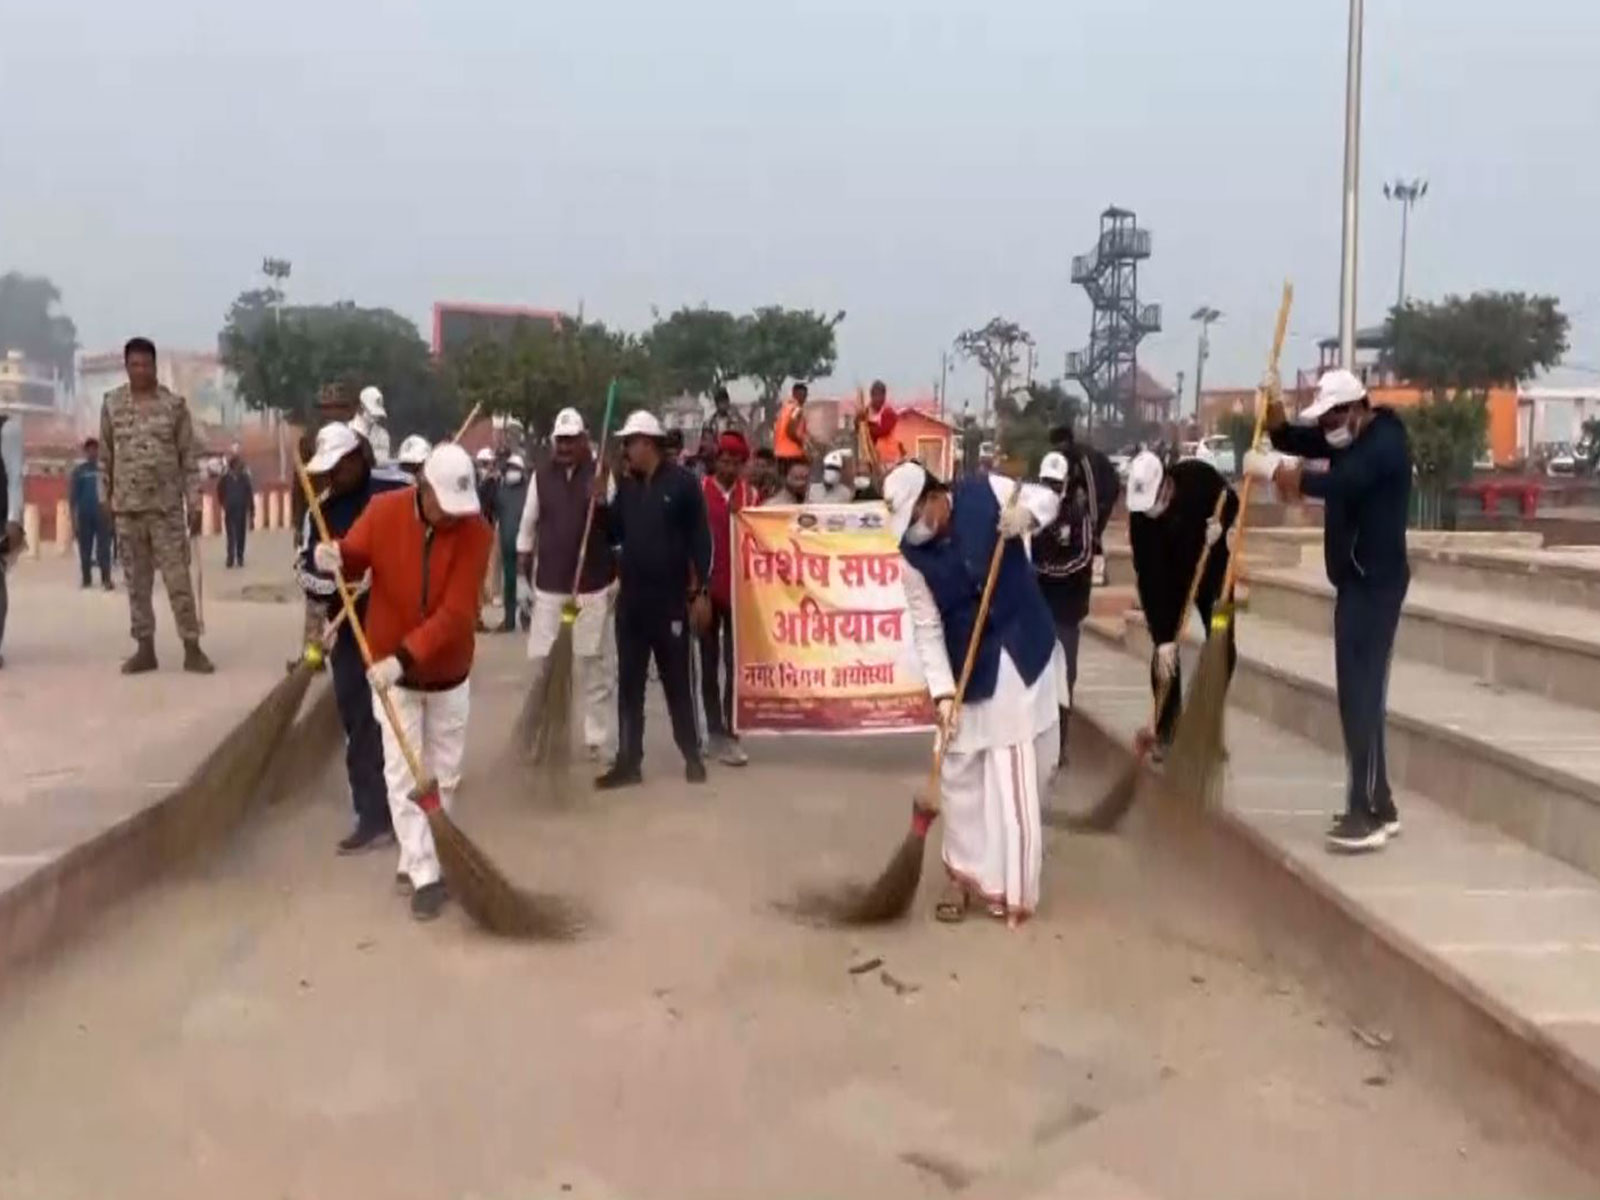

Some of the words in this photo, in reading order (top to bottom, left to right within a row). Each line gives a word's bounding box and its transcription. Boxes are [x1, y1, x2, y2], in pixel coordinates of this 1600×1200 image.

[742, 533, 829, 586] विशेष
[838, 553, 901, 586] सफ
[773, 597, 904, 647] अभियान
[744, 662, 775, 688] नगर
[779, 662, 826, 688] निगम
